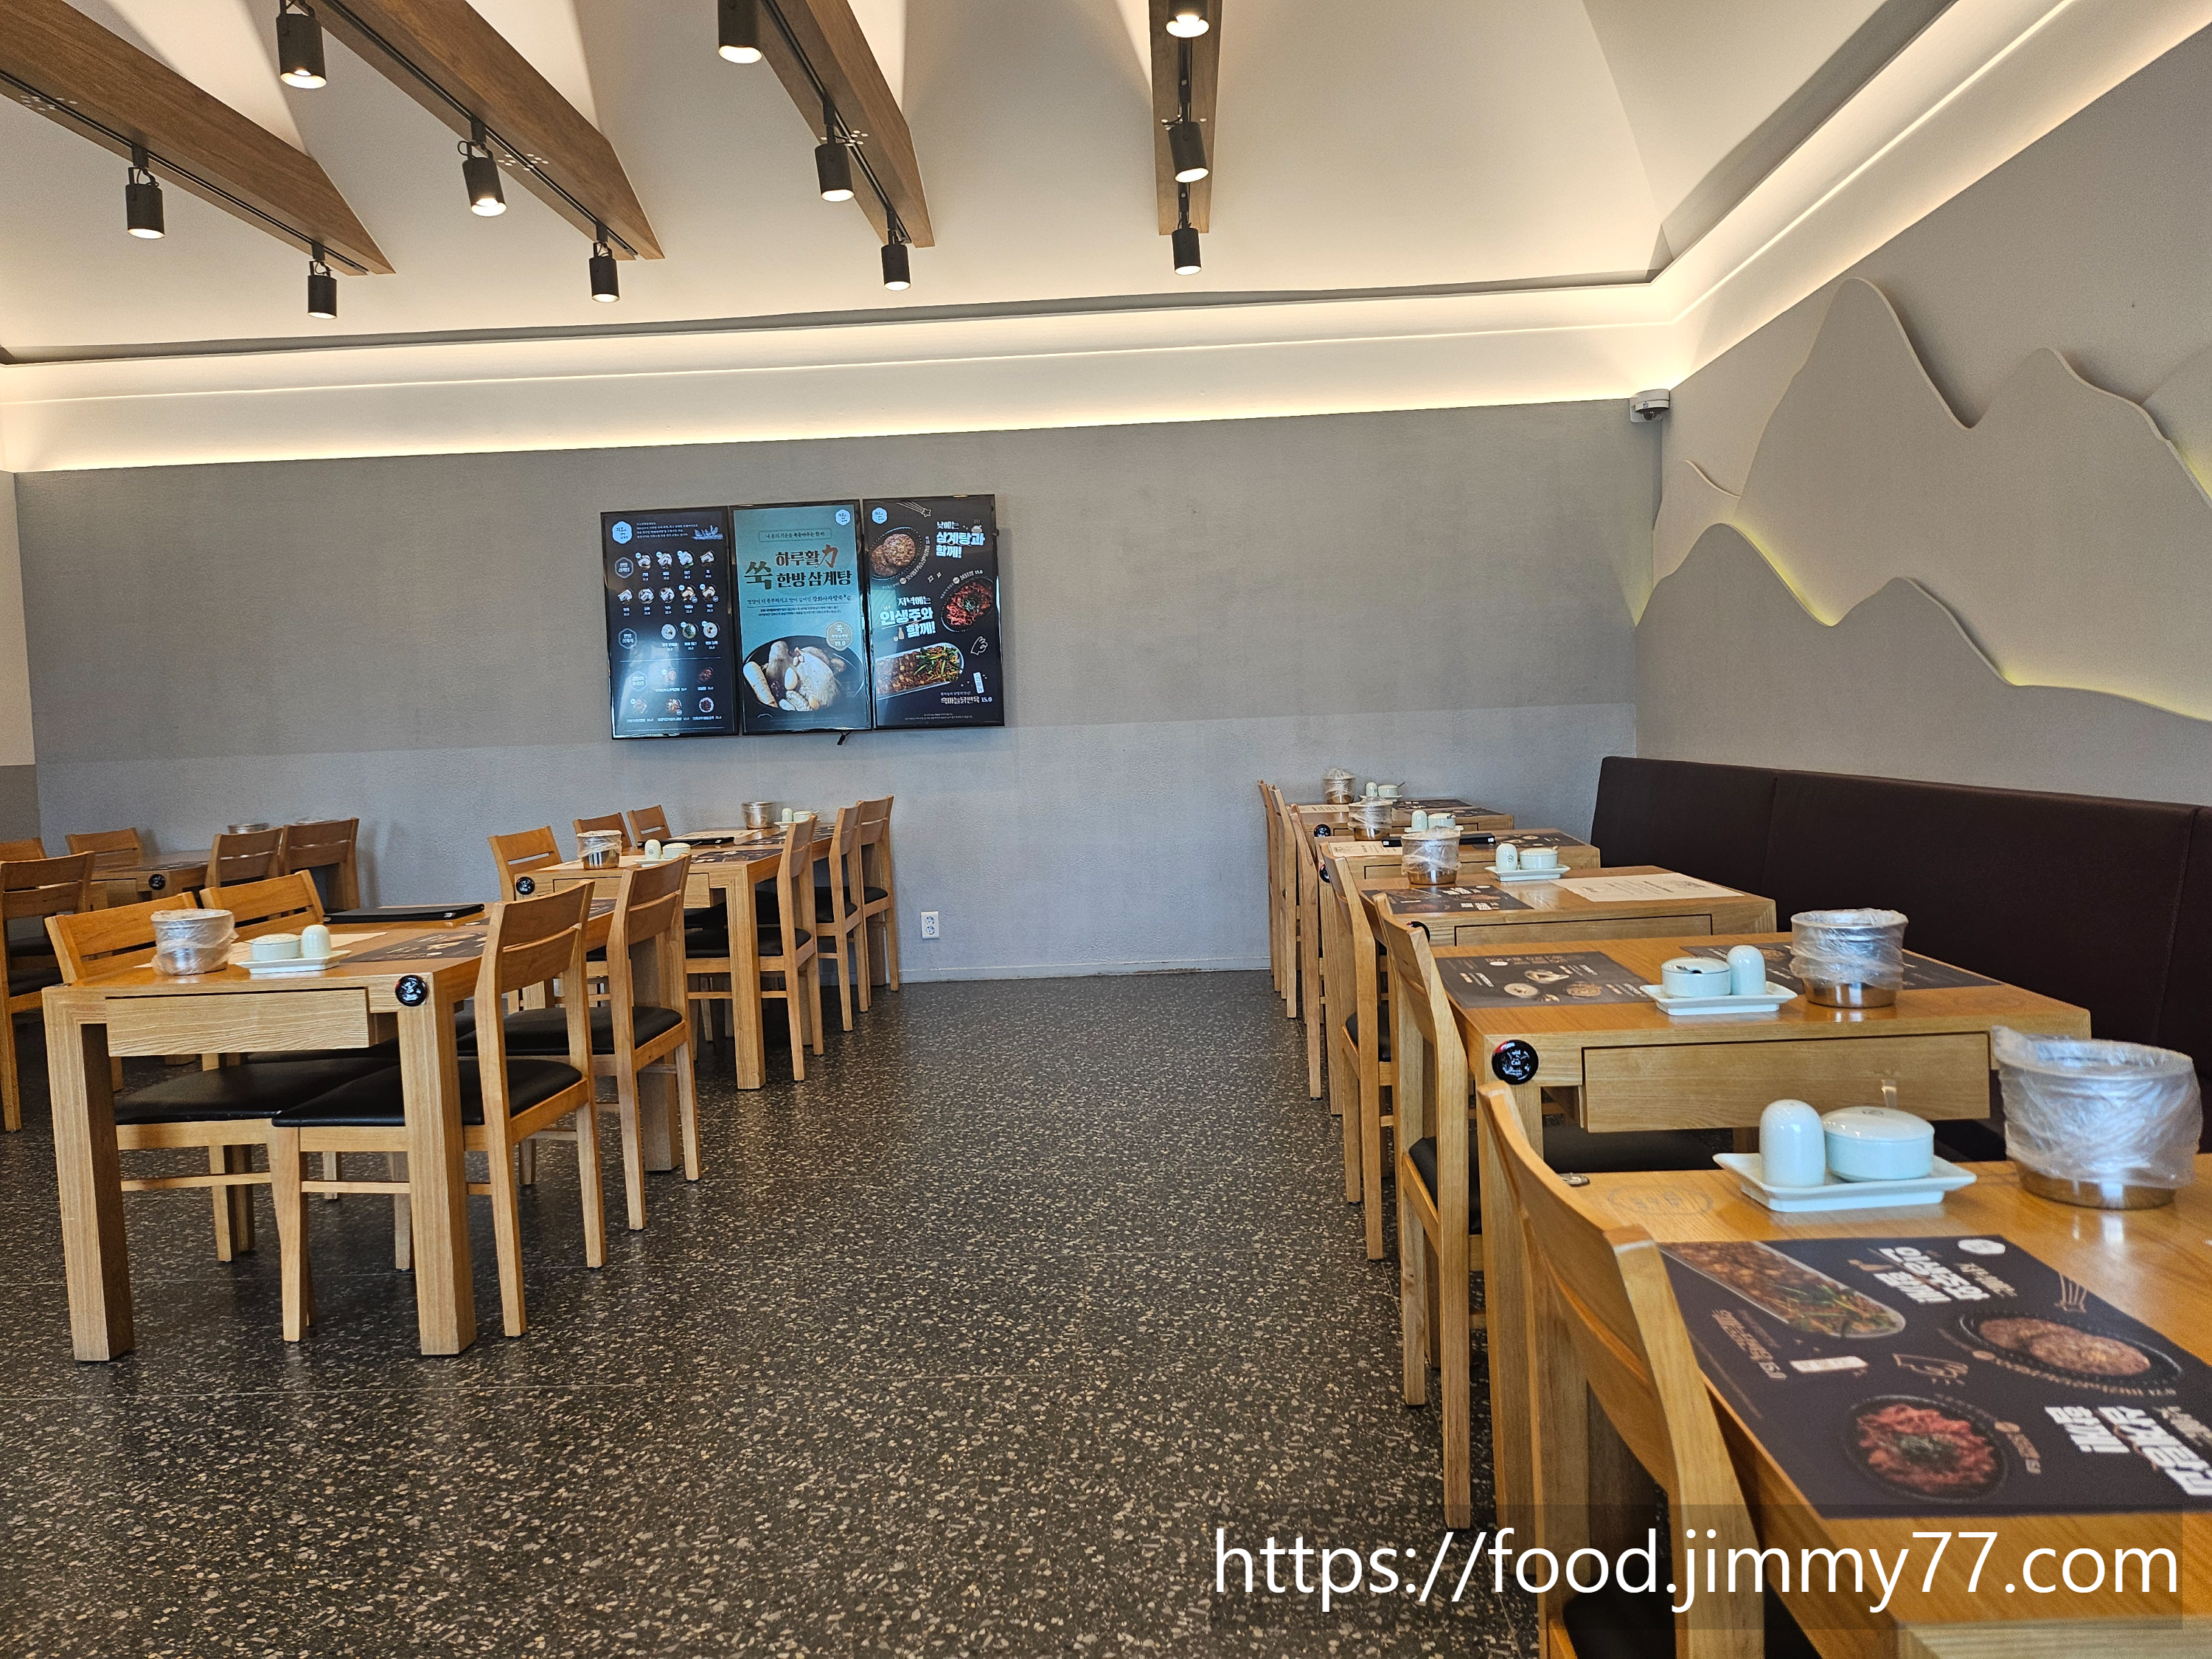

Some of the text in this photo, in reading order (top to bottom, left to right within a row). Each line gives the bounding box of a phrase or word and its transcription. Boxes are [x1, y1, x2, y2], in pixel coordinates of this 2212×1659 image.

[936, 521, 959, 529] 낮에는
[936, 532, 985, 546] 삼계탕과
[936, 546, 962, 558] 함께!
[743, 560, 852, 590] 쑥 한방 삼계탕
[898, 596, 931, 606] 저녁에는
[880, 607, 933, 625] 인생주와
[906, 622, 936, 639] 함께!
[1879, 1247, 1991, 1300] 인생주와
[2045, 1406, 2130, 1453] 함께!
